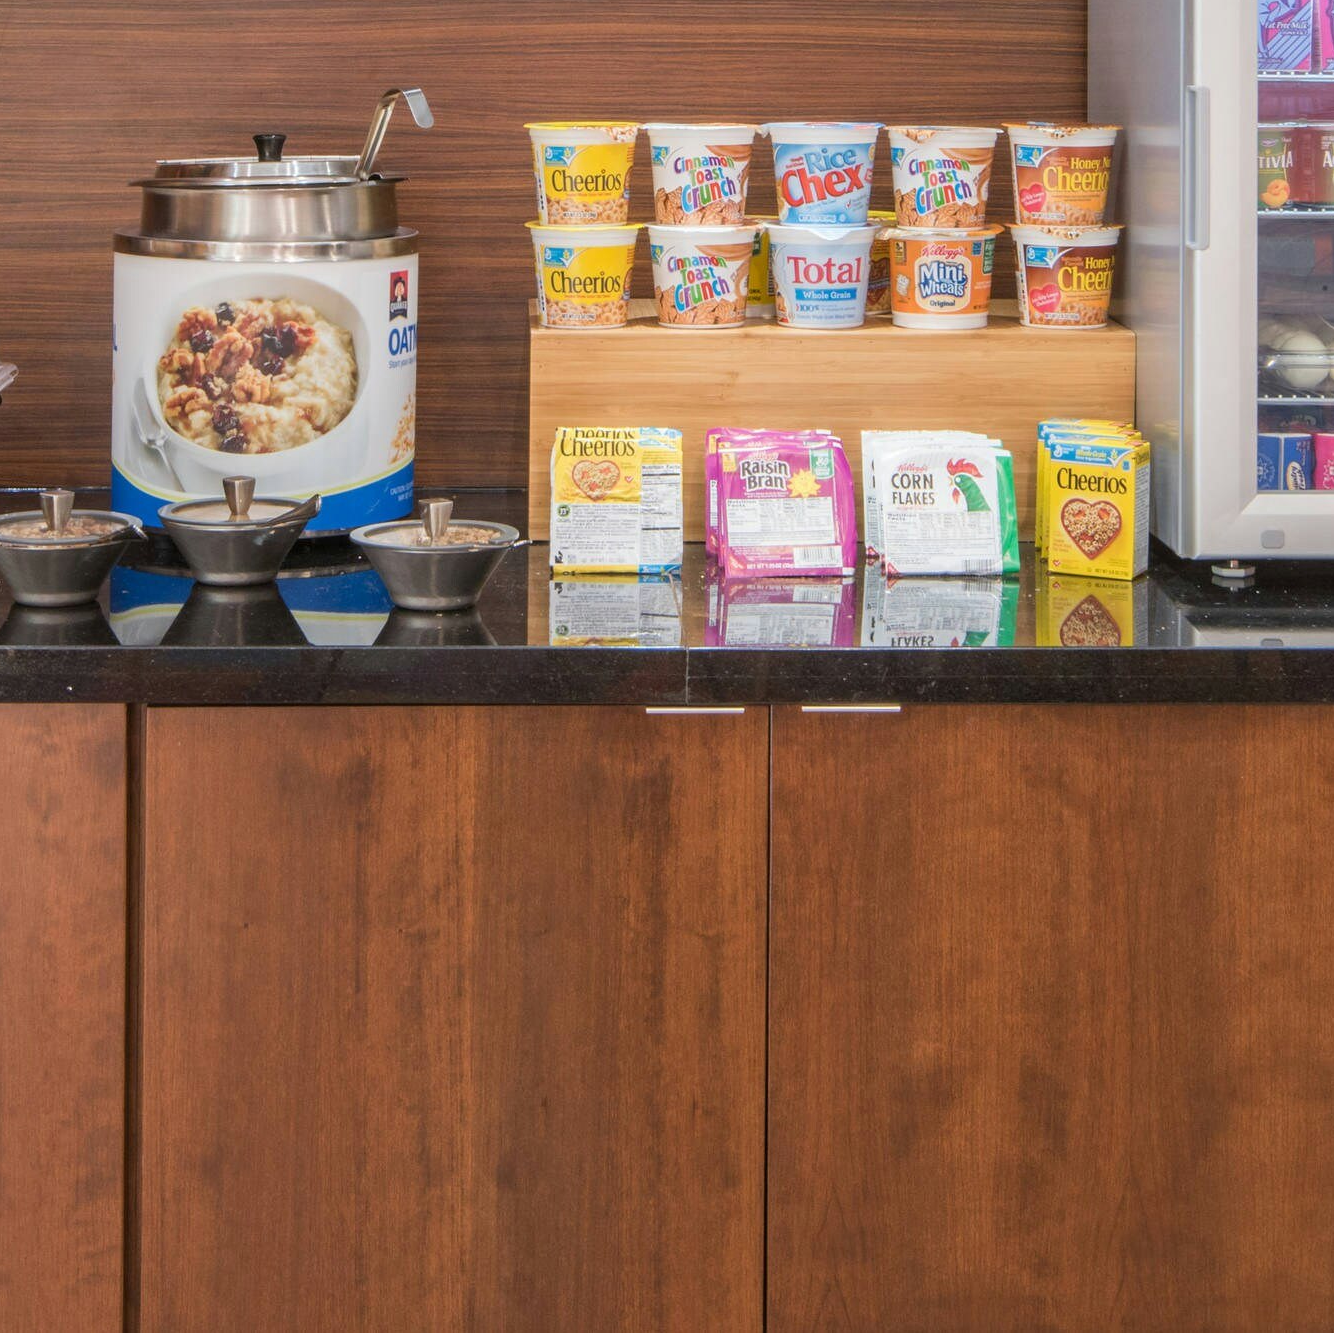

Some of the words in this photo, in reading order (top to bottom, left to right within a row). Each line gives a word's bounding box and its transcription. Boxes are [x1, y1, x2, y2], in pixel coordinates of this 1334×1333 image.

[674, 155, 734, 174] Cinnamon
[804, 148, 856, 174] Rice
[909, 157, 970, 176] Cinnamon
[1071, 158, 1100, 173] Honey
[552, 169, 621, 192] Cheerios
[689, 167, 725, 185] Toast
[781, 163, 864, 207] Chex
[922, 170, 958, 189] Toast
[1042, 166, 1110, 192] Cheerio
[681, 177, 736, 214] Crunch
[915, 180, 972, 216] Crunch
[922, 243, 965, 259] Kellogg's
[667, 255, 727, 273] Cinnamon
[787, 256, 861, 284] Total
[919, 261, 964, 283] Mini
[1085, 257, 1110, 272] Honey
[551, 271, 620, 294] Cheerios
[680, 267, 716, 286] Toast
[674, 276, 731, 313] Crunch
[803, 291, 829, 300] Whole
[830, 291, 852, 299] Grain
[920, 279, 964, 298] Wheats
[930, 299, 955, 308] Original
[560, 437, 635, 457] Cheerios
[741, 460, 788, 477] Raisin
[747, 475, 785, 489] Bran
[891, 473, 934, 490] CORN
[1057, 467, 1127, 495] Cheerios
[892, 491, 935, 505] FLAKES
